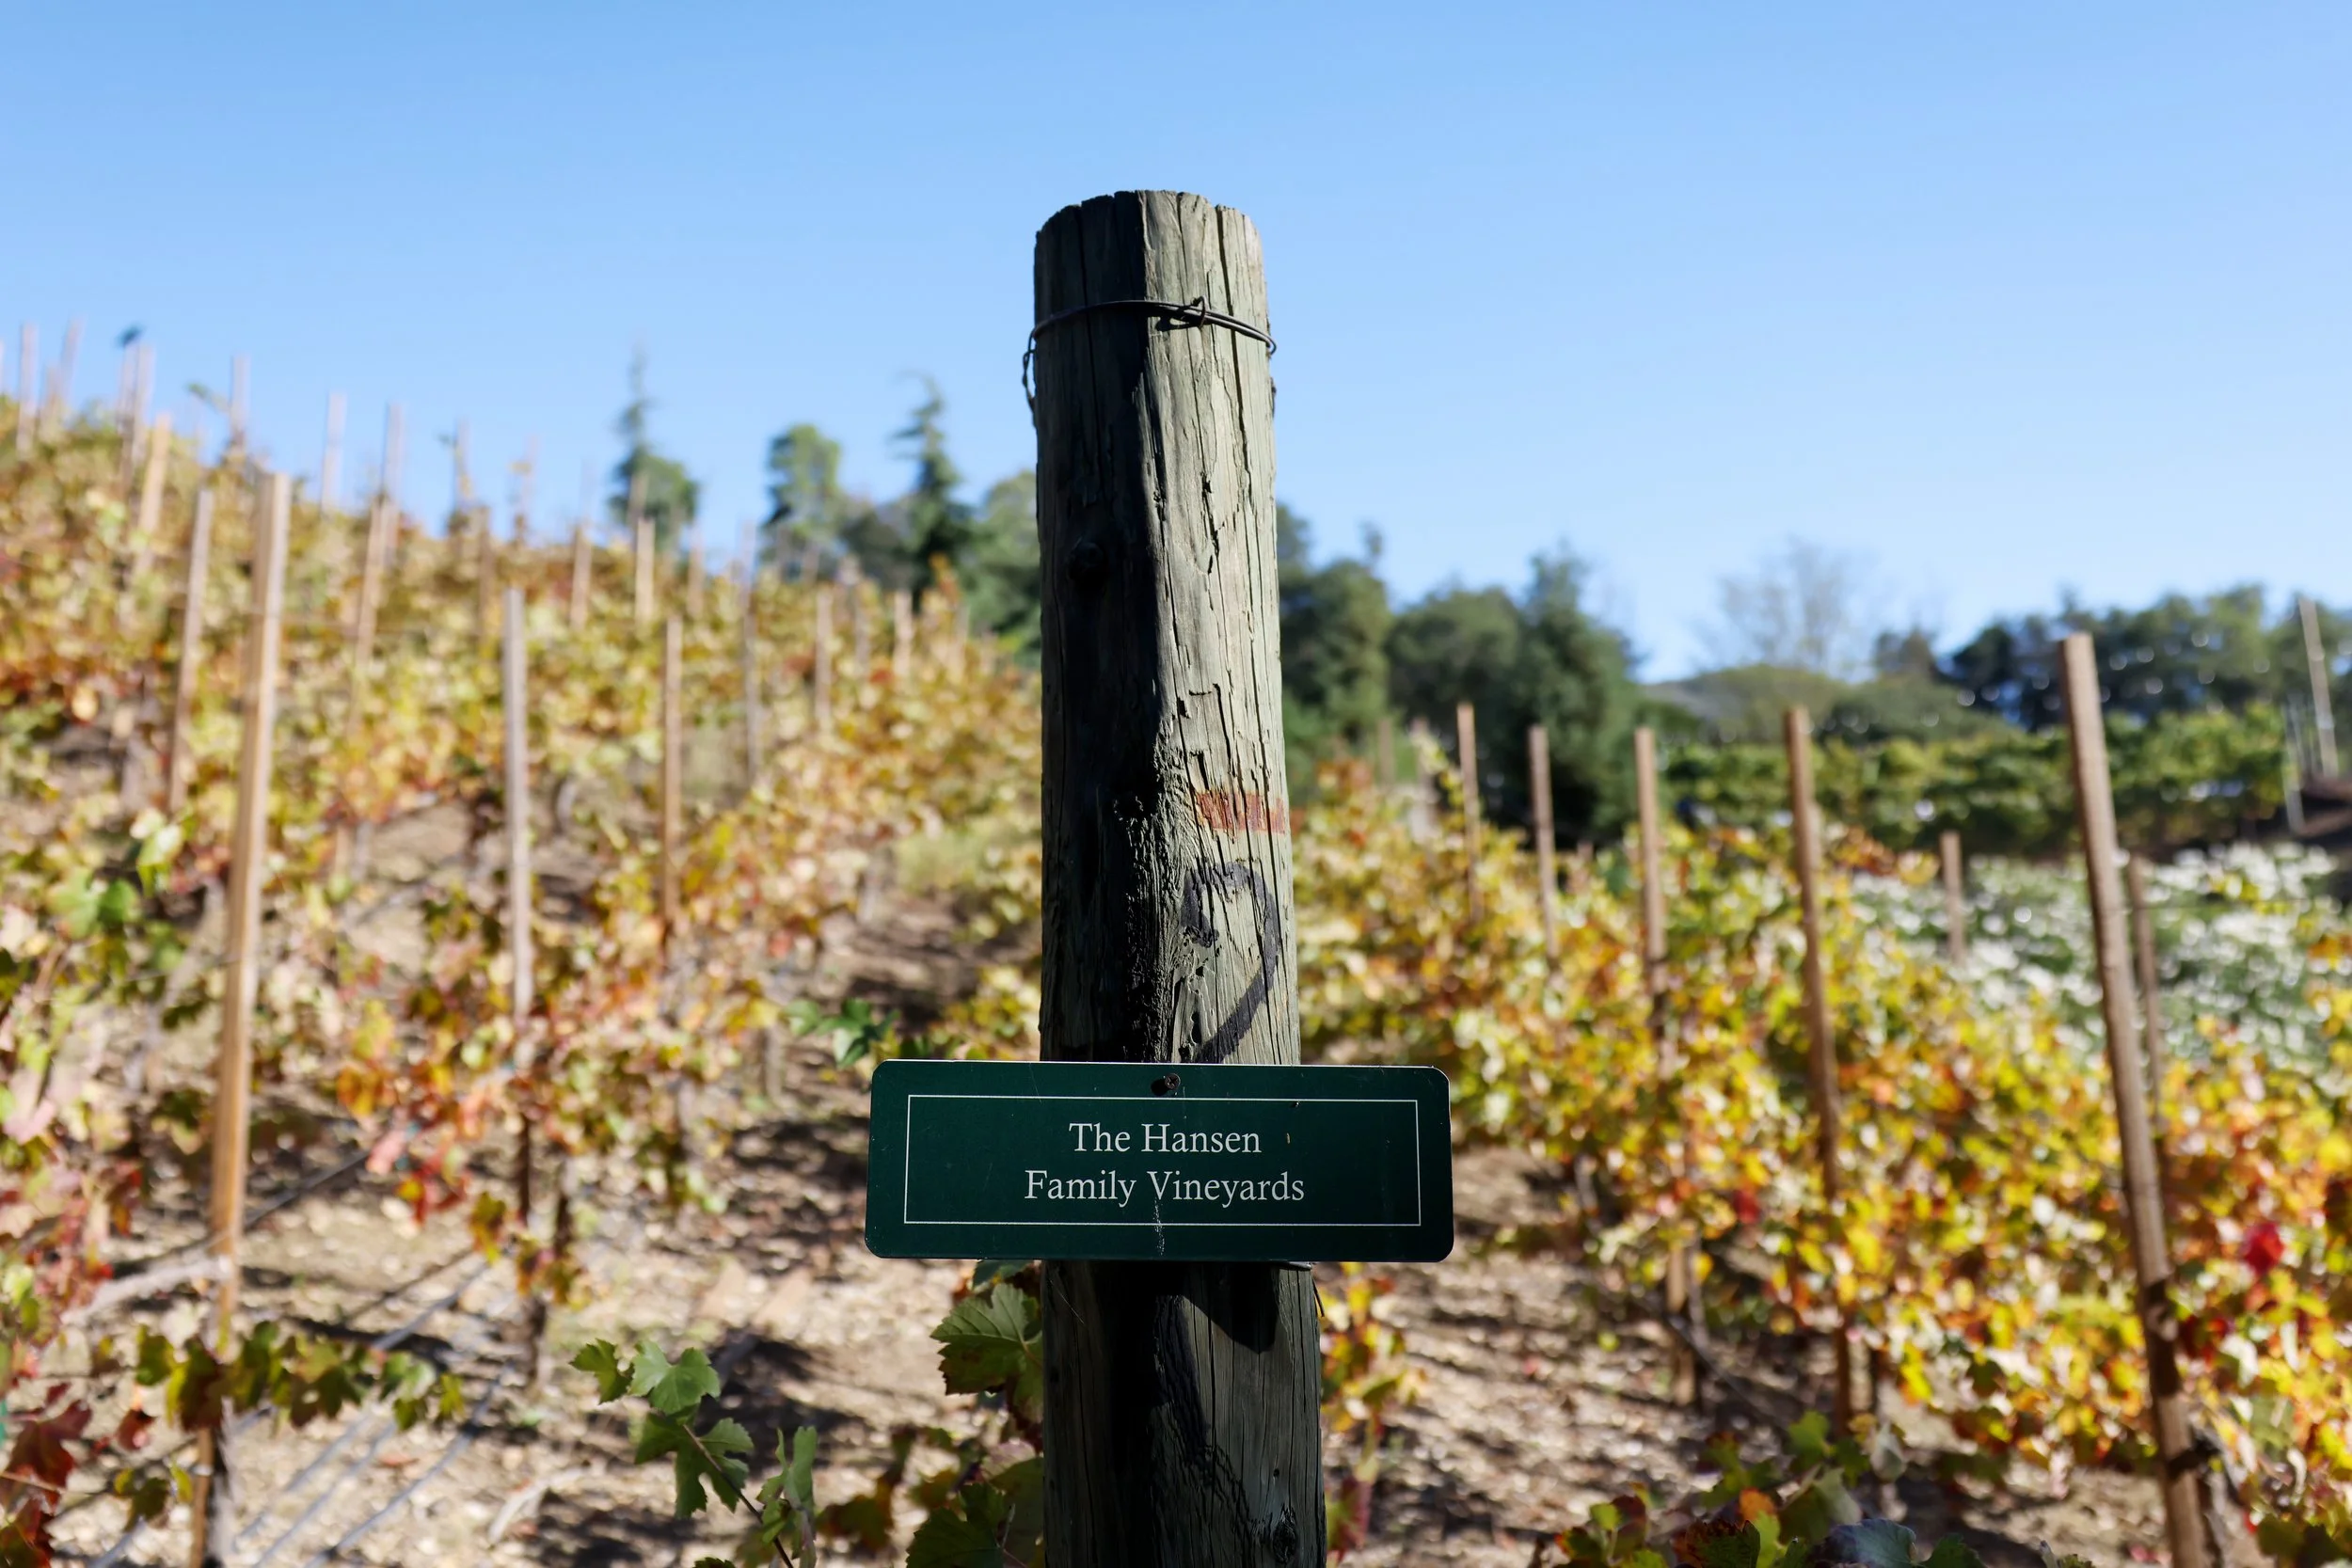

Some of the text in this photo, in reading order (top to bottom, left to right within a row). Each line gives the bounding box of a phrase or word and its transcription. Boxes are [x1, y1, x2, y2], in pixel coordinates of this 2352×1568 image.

[1069, 1122, 1263, 1153] The Hansen
[1025, 1169, 1305, 1208] Family Vineyards
